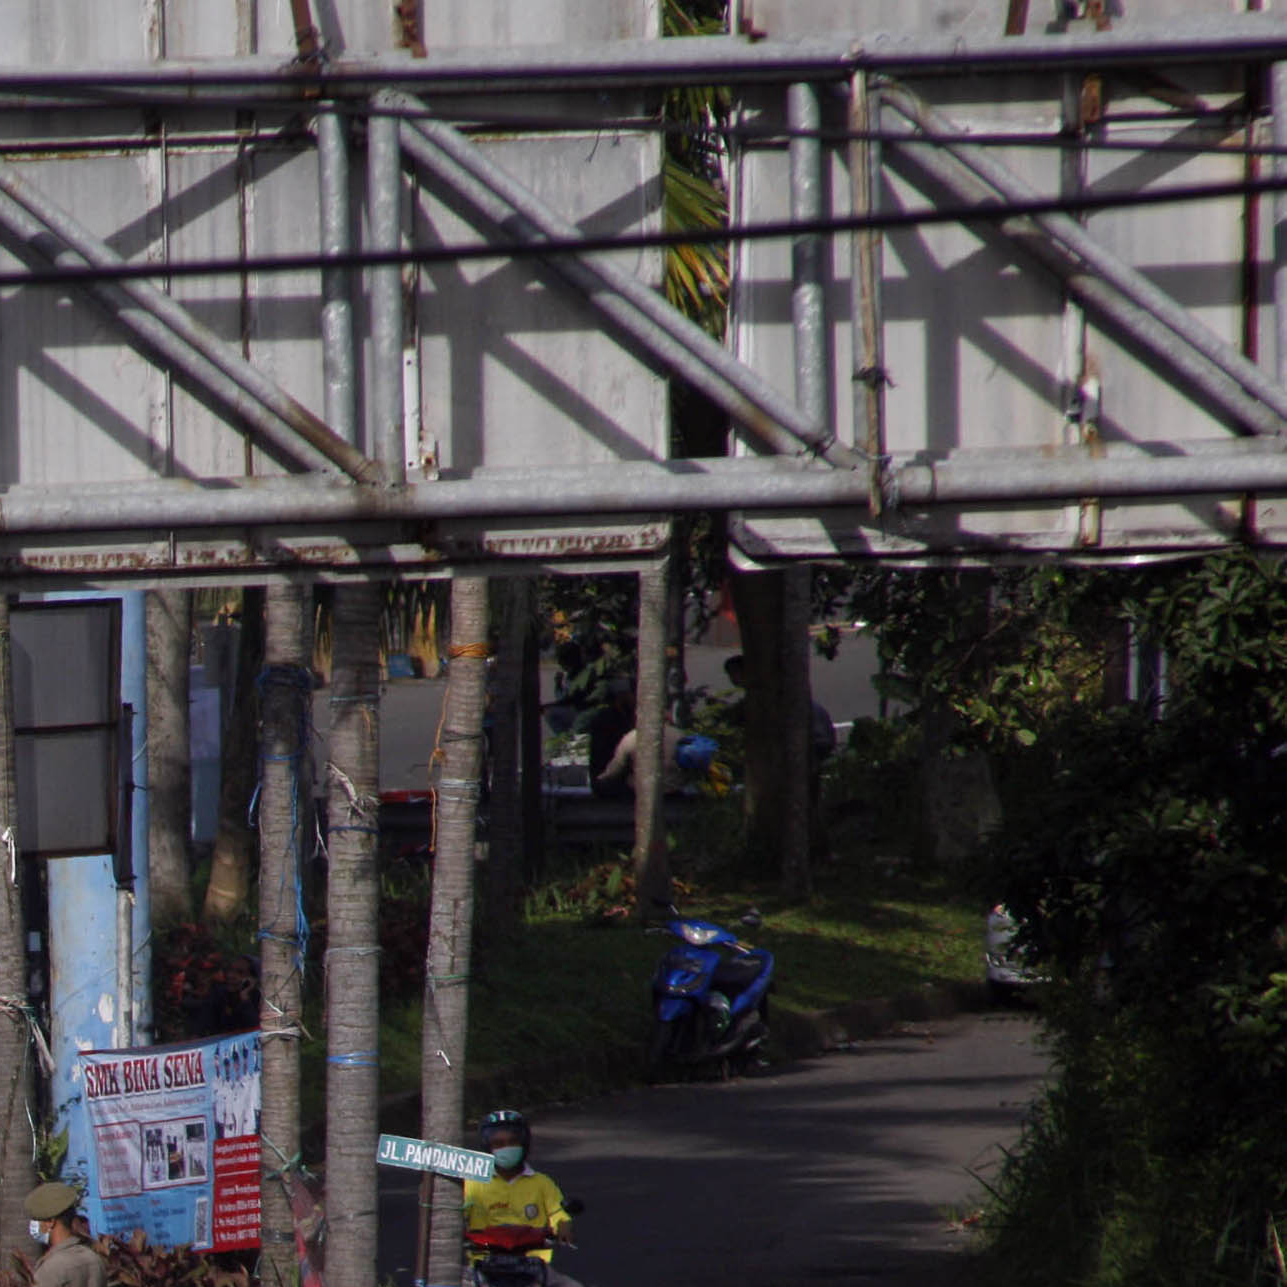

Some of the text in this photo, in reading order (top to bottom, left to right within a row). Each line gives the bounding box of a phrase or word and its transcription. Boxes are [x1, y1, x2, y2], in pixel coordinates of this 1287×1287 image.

[84, 1051, 206, 1098] SMK BINA SENA
